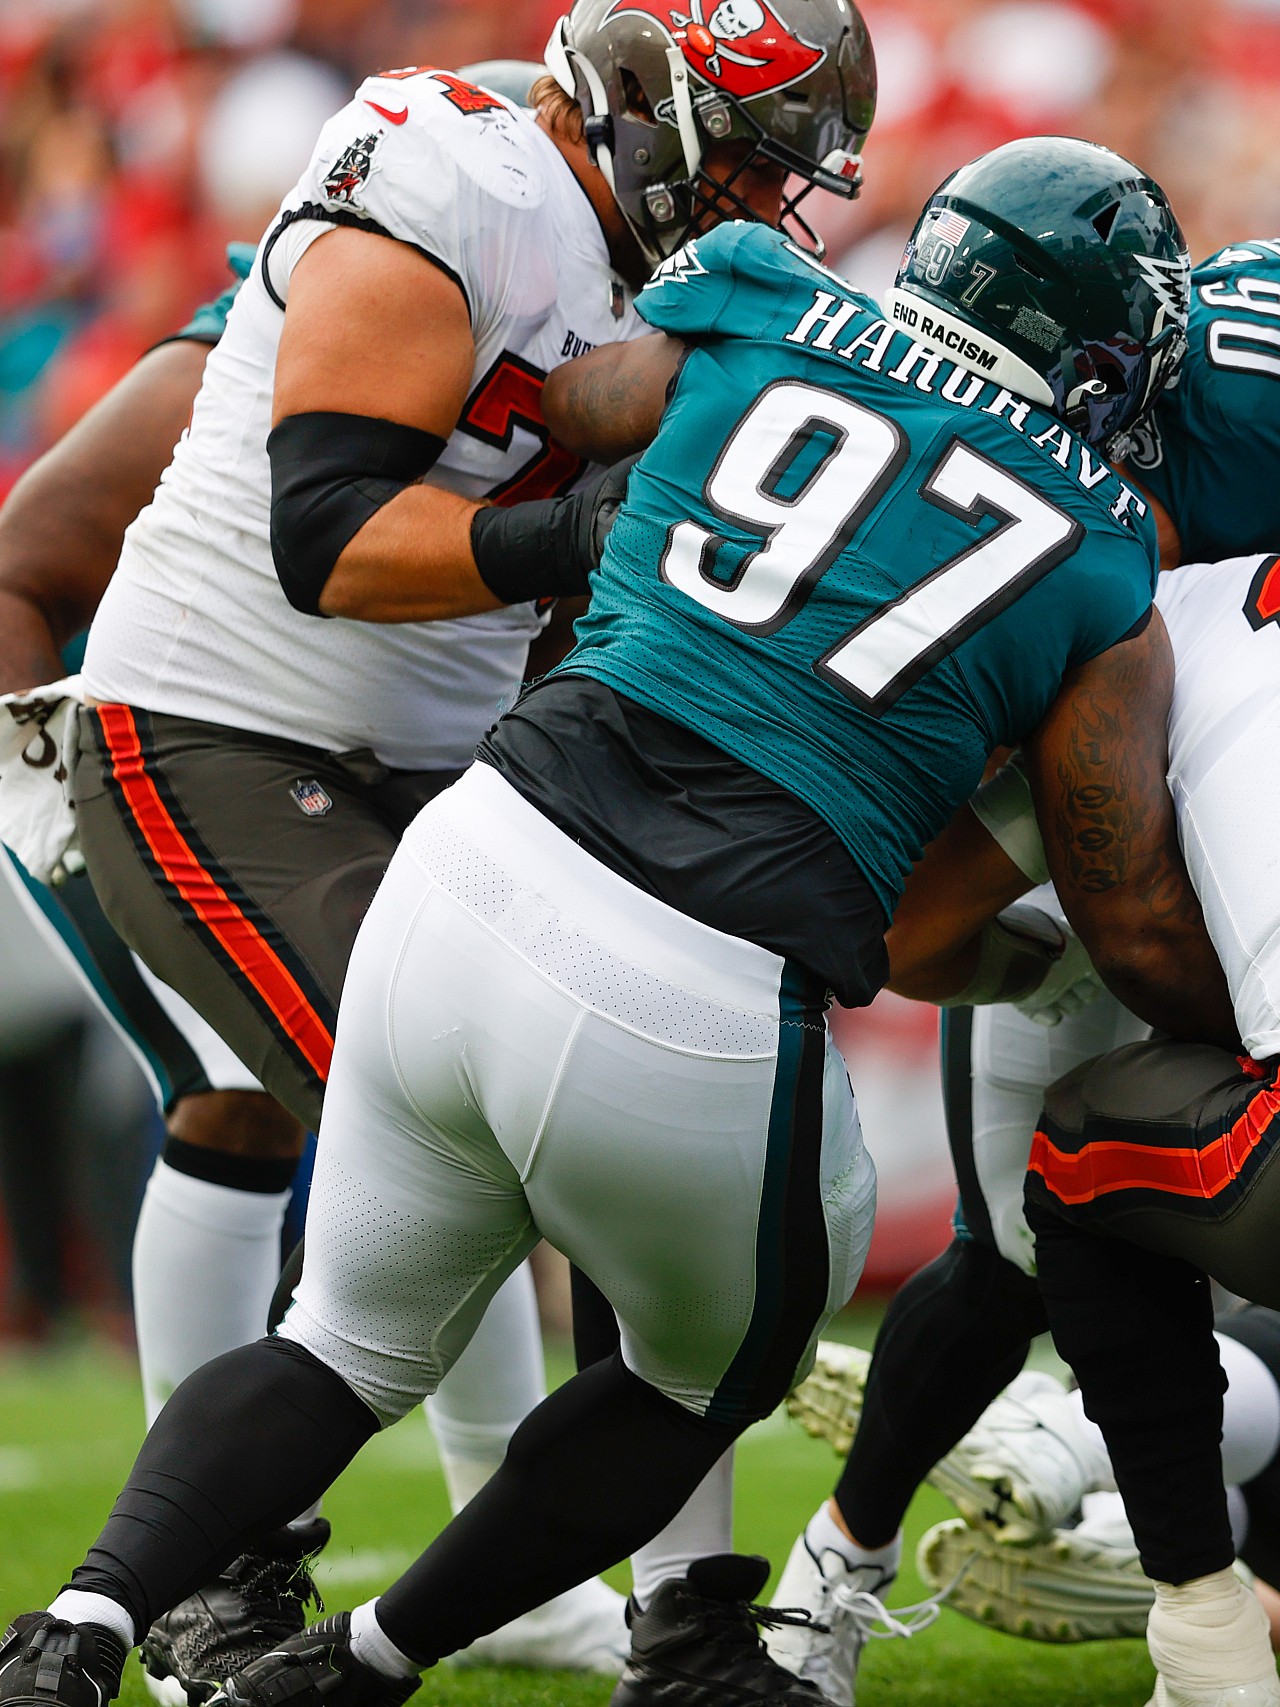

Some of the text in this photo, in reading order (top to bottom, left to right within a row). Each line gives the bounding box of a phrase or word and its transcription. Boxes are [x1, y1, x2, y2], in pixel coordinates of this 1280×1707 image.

[925, 240, 998, 306] 97
[892, 301, 918, 327] END
[921, 316, 999, 371] RACISM
[658, 376, 1087, 718] 97
